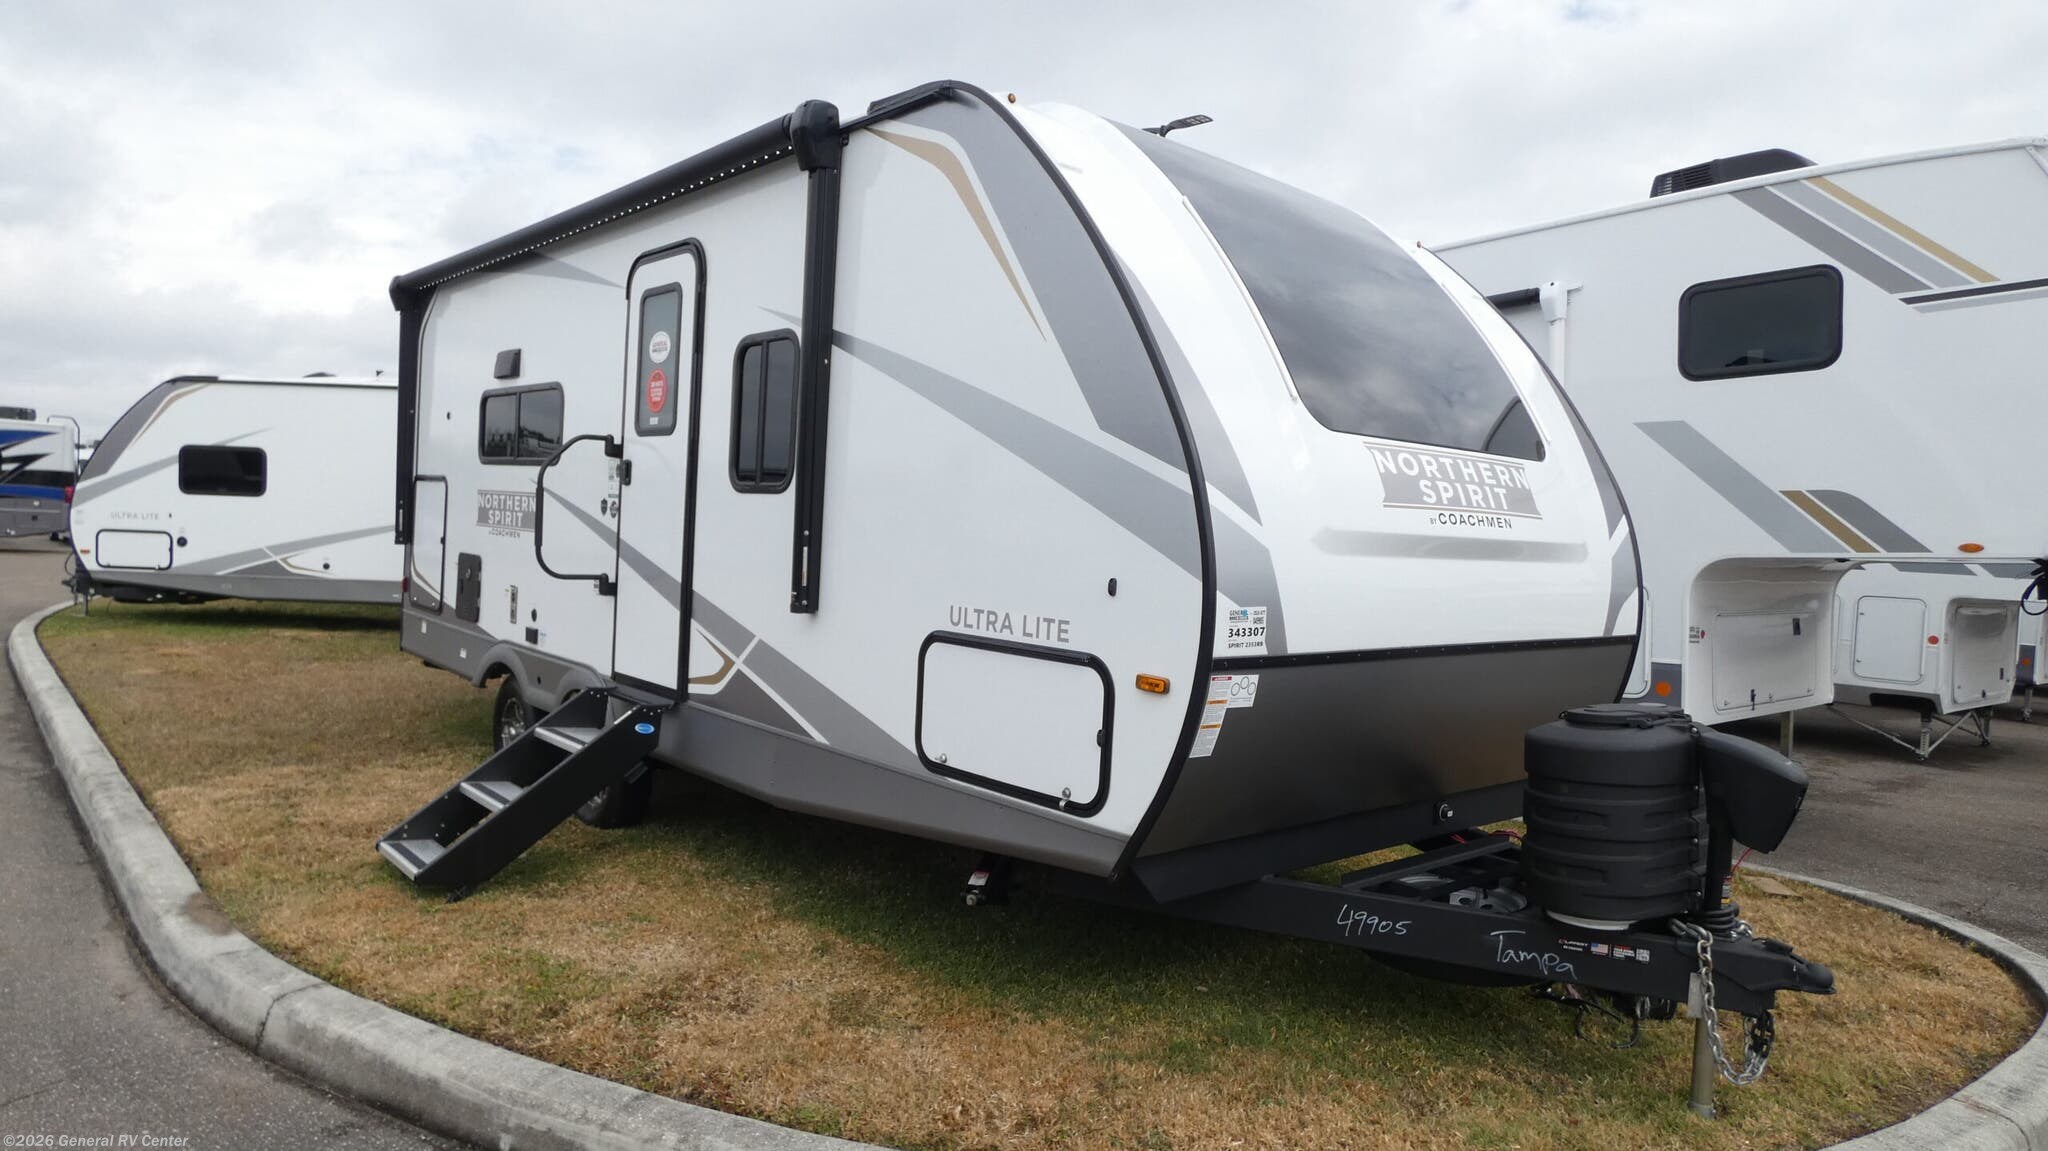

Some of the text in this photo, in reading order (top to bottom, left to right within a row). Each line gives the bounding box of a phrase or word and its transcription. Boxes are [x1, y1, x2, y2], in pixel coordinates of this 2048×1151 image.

[1370, 448, 1530, 490] NORTHERN
[479, 493, 536, 513] NORTHERN
[1419, 478, 1509, 511] SPIRIT
[488, 510, 523, 527] SPIRIT
[1437, 513, 1513, 529] COACHMEN
[949, 605, 1070, 643] ULTRA LITE
[1228, 626, 1265, 638] 343307
[1337, 904, 1413, 937] 49905
[1489, 929, 1578, 980] Tampa
